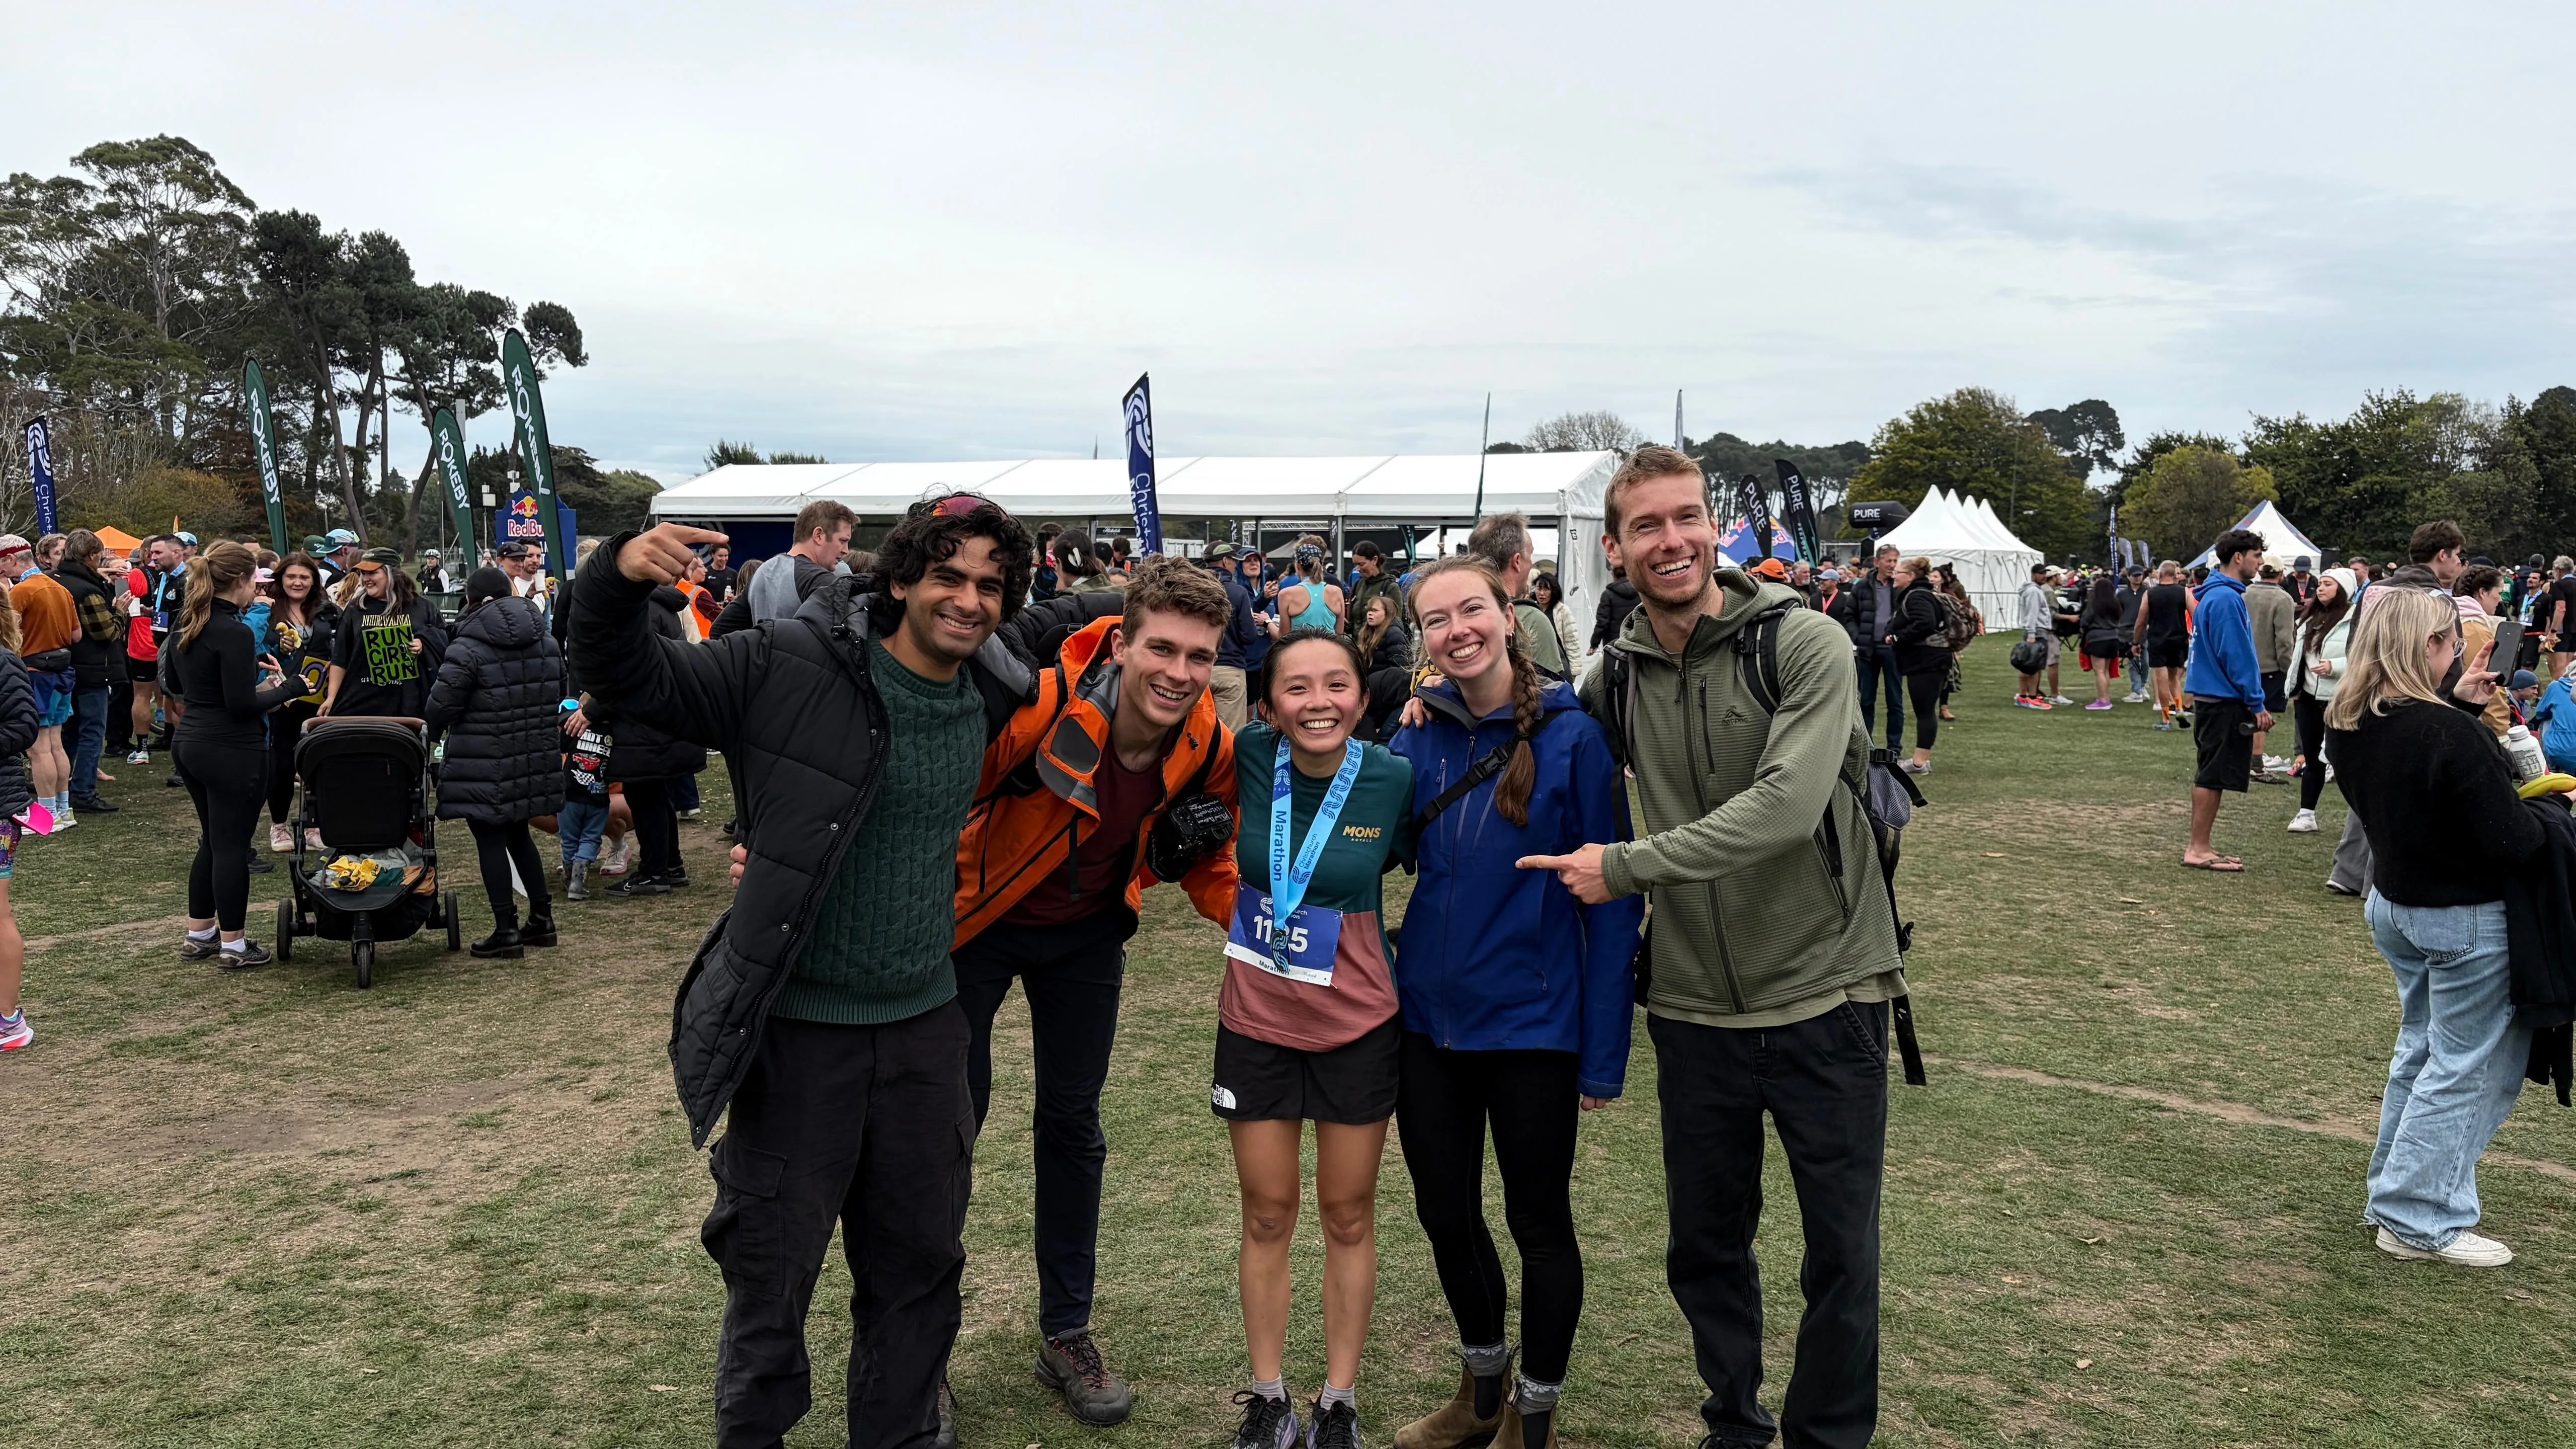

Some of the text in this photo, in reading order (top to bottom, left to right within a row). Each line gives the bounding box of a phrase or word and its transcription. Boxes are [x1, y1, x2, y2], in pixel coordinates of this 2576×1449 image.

[251, 388, 280, 504] ROKEBY
[512, 364, 550, 495] ROKEBY
[439, 428, 470, 509] ROKEBY
[1745, 482, 1767, 533] PURE
[1788, 475, 1804, 513] PURE
[529, 519, 544, 537] Bu
[1854, 508, 1881, 519] PURE
[365, 628, 414, 649] RUN
[372, 662, 417, 685] RUN
[1273, 811, 1286, 881] Marathon
[1342, 826, 1381, 838] MONS
[1299, 833, 1318, 868] Christchurch
[1304, 842, 1320, 870] Marathon
